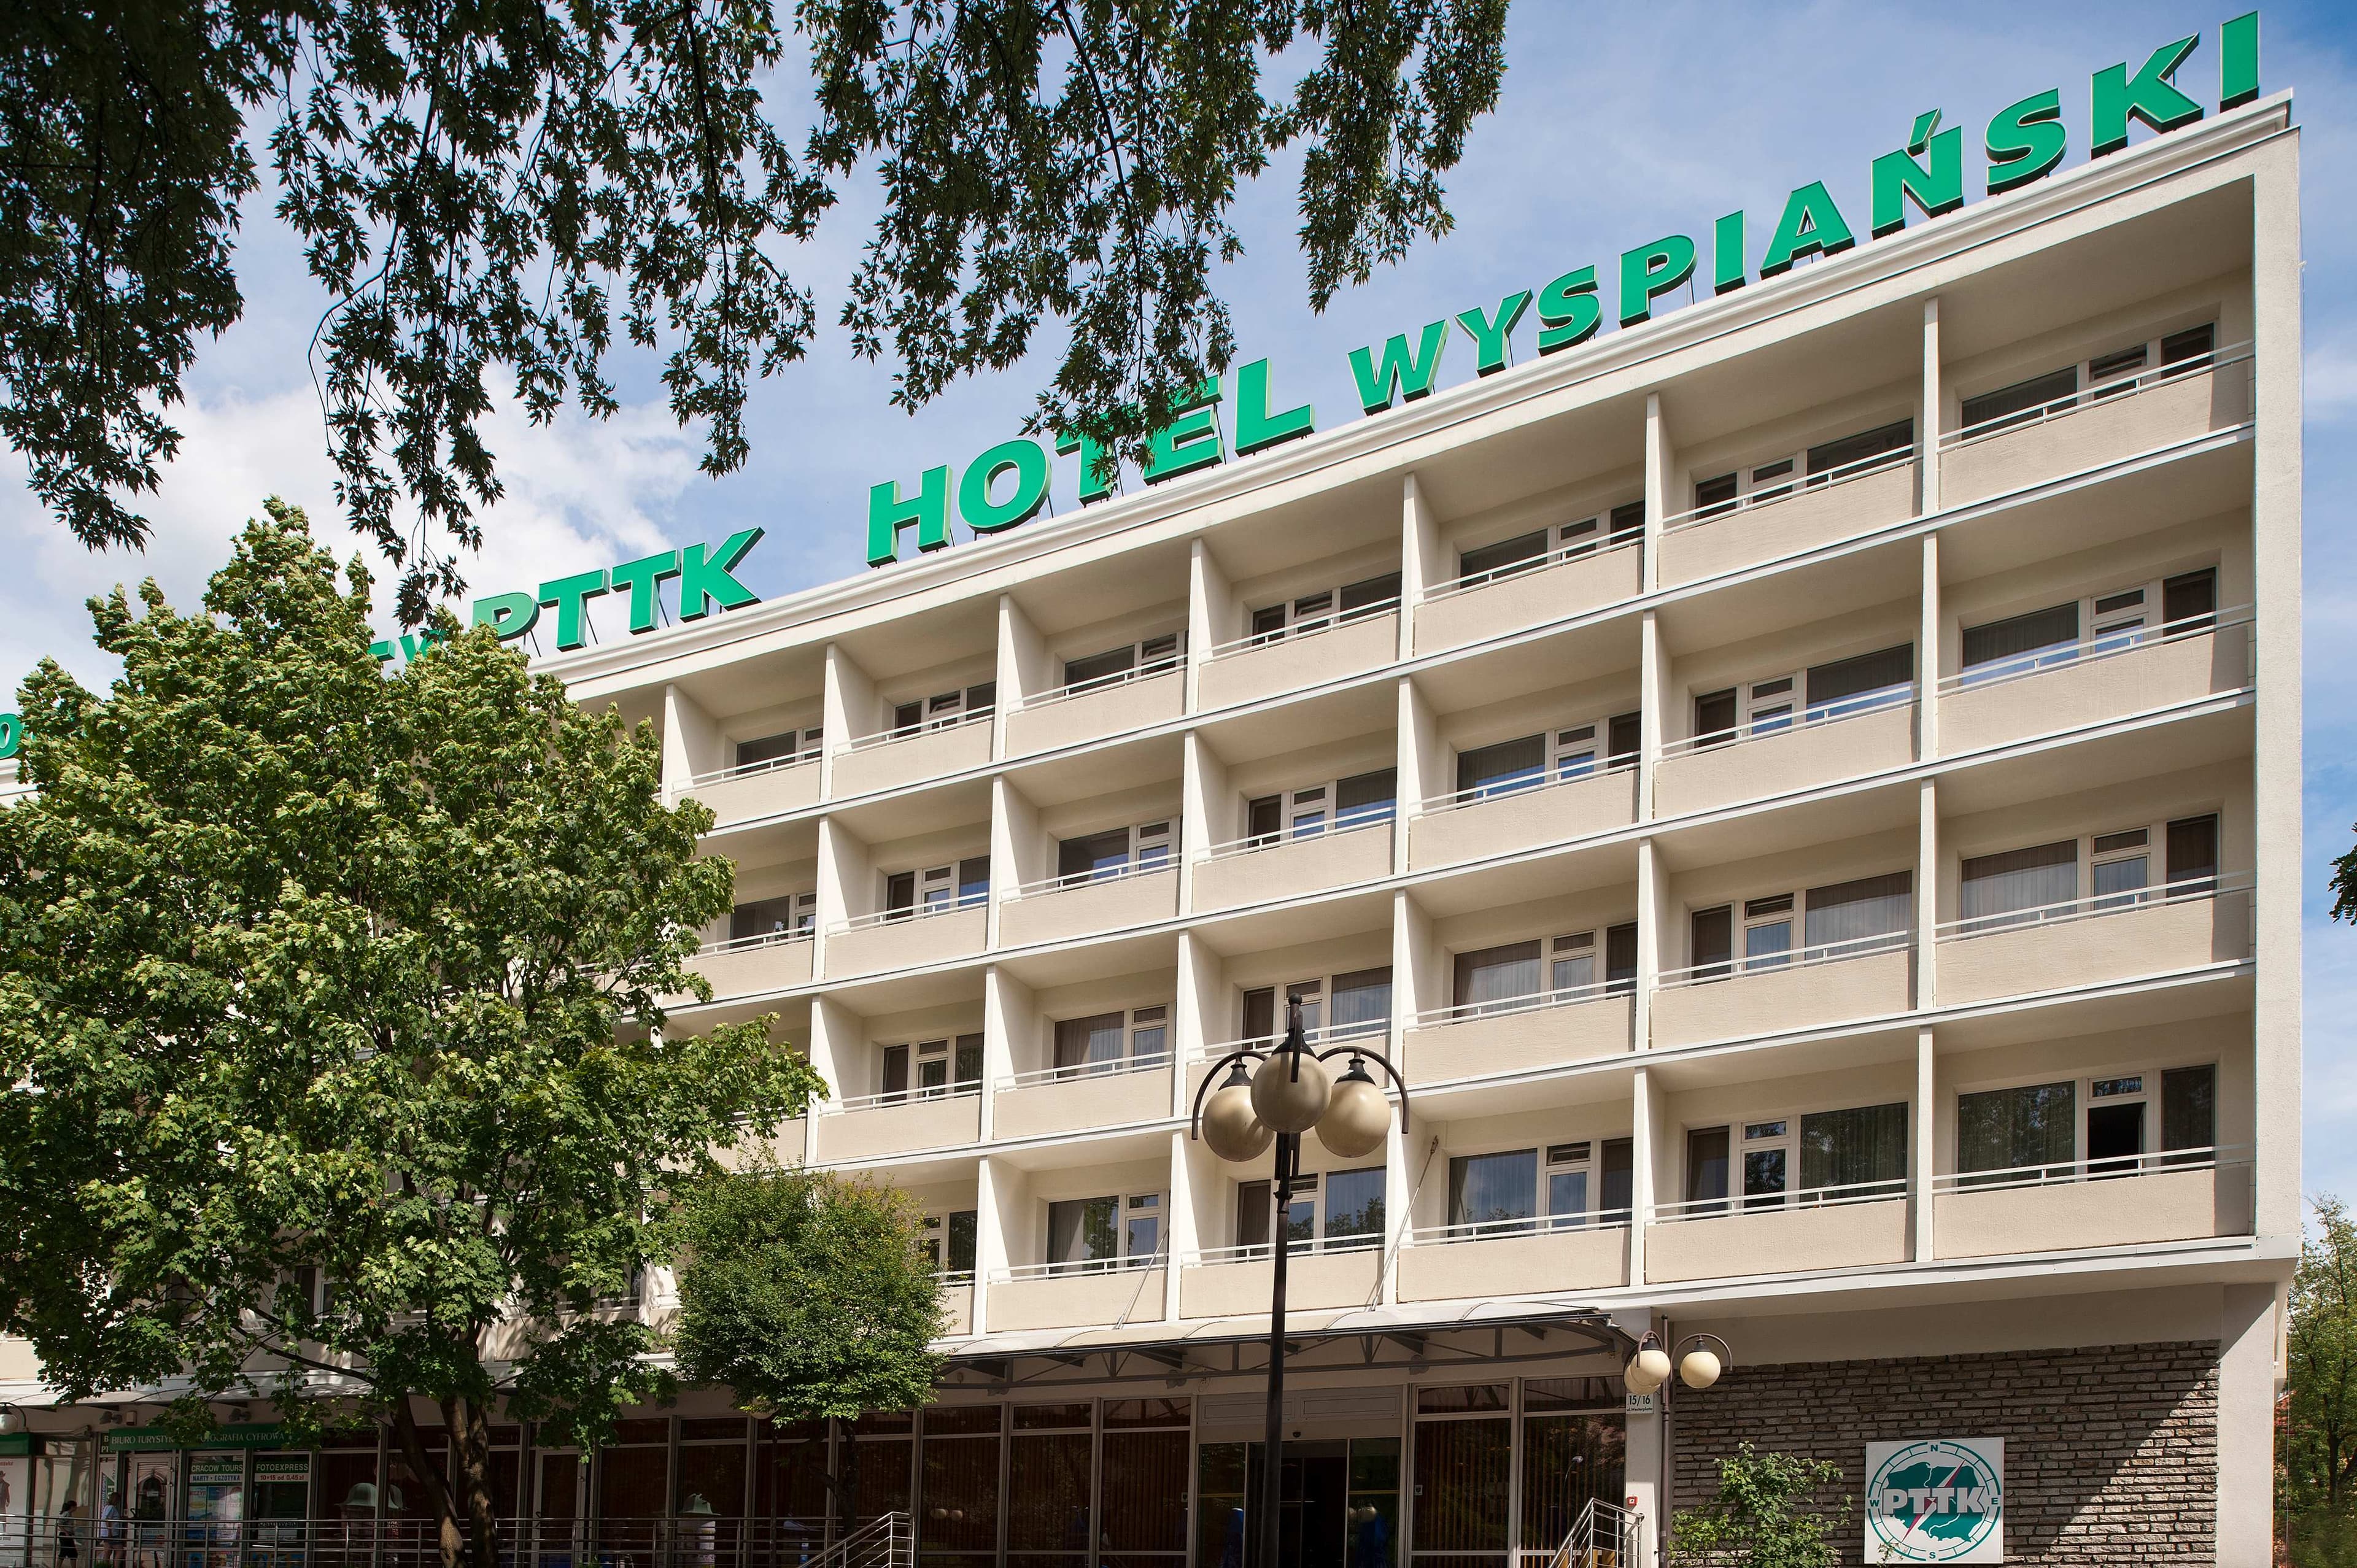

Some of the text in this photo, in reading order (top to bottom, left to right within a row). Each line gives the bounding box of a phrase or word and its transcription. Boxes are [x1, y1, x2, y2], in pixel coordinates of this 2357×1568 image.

[472, 9, 2259, 653] PTTK HOTEL WYSPIAŃSKI
[1629, 1395, 1651, 1406] 15/16
[111, 1435, 136, 1444] BIURO
[246, 1432, 285, 1442] CYFROWA
[1882, 1486, 1986, 1515] PTTK
